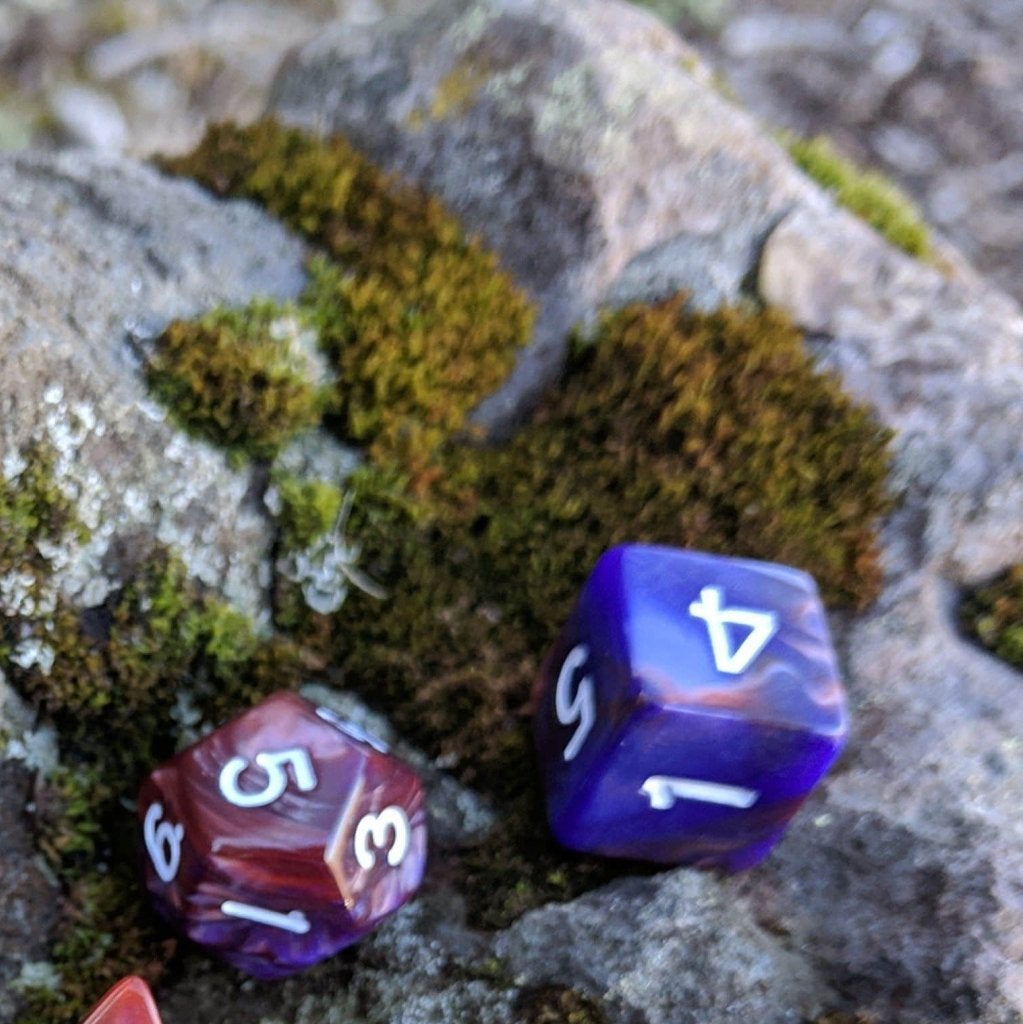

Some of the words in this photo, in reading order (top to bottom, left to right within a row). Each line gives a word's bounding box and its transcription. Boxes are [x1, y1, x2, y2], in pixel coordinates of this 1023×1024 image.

[690, 585, 777, 674] 4
[555, 645, 595, 761] 5
[218, 747, 318, 809] 5
[640, 774, 759, 810] 1
[354, 804, 409, 870] 3
[220, 899, 312, 935] 1
